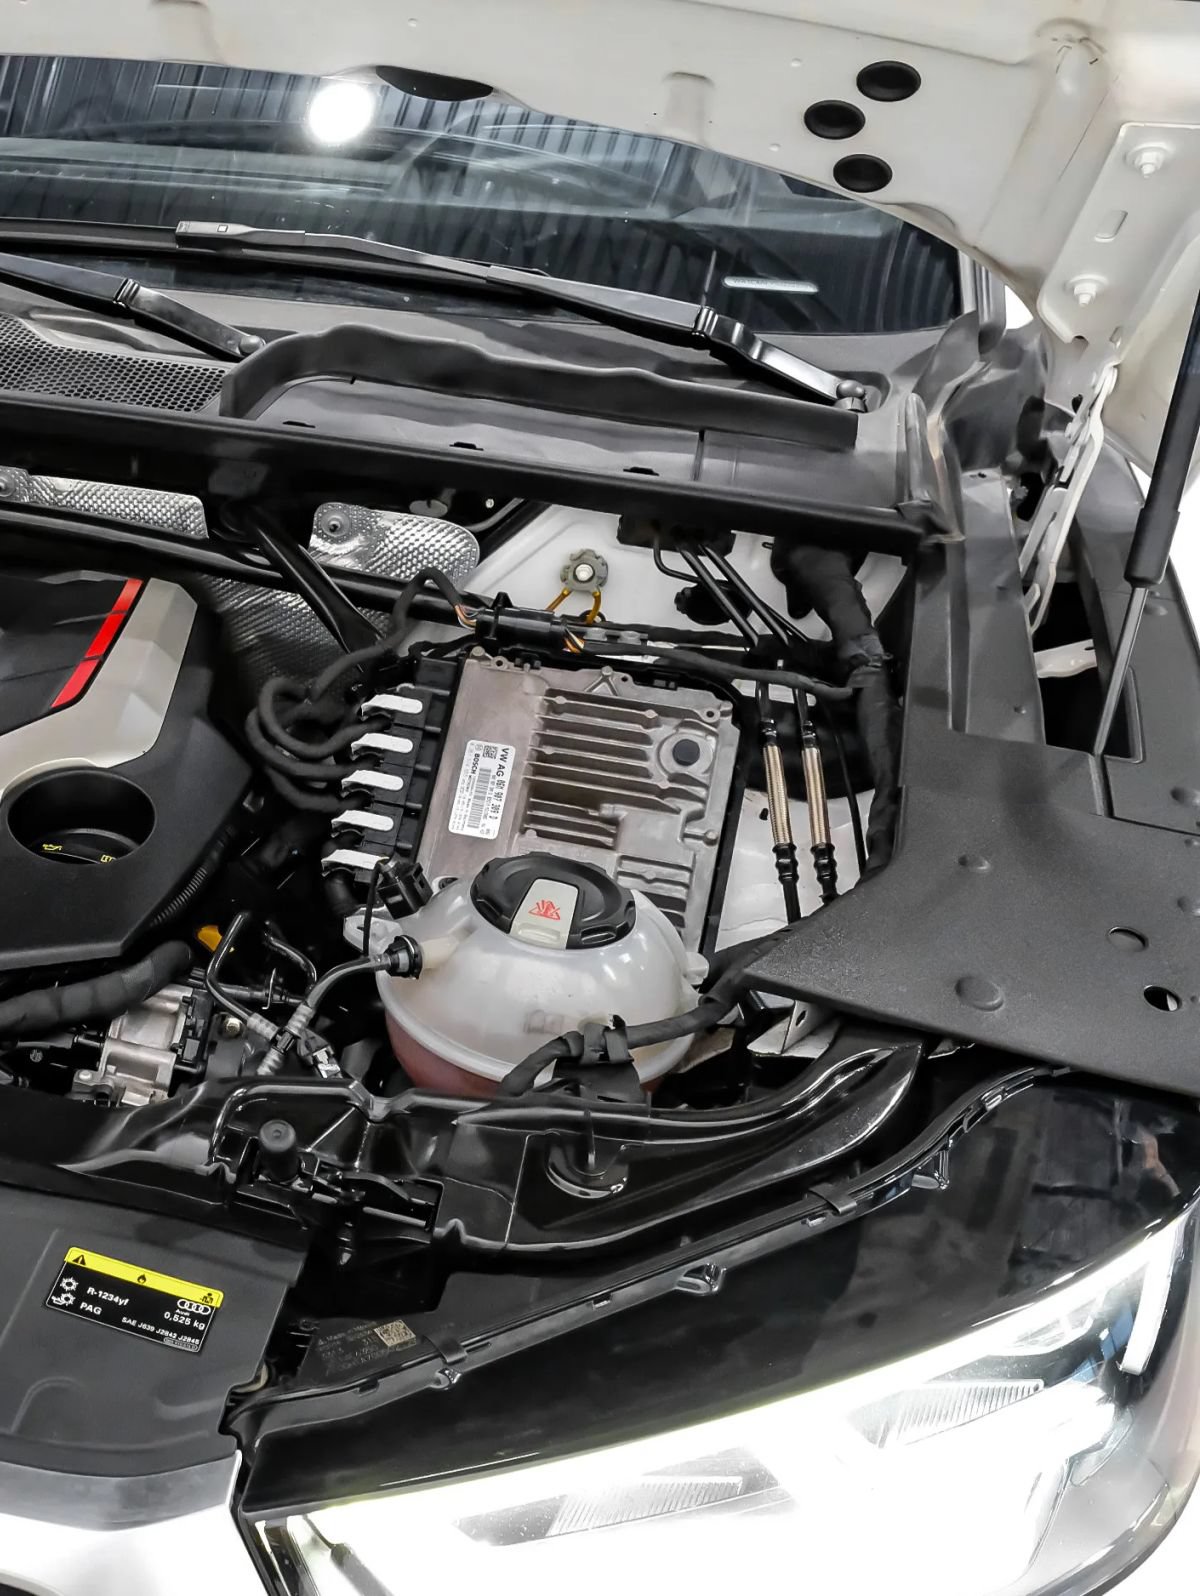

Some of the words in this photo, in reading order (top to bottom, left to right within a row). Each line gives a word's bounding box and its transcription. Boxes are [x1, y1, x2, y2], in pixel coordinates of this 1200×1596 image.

[499, 747, 509, 762] VW
[470, 753, 480, 774] BOSCH
[495, 763, 505, 777] AG
[86, 1286, 130, 1306] R-1234yf
[79, 1301, 102, 1315] PAG
[121, 1316, 136, 1326] SAE
[137, 1321, 155, 1332] J639
[163, 1311, 191, 1326] 0,525
[193, 1319, 206, 1331] kg
